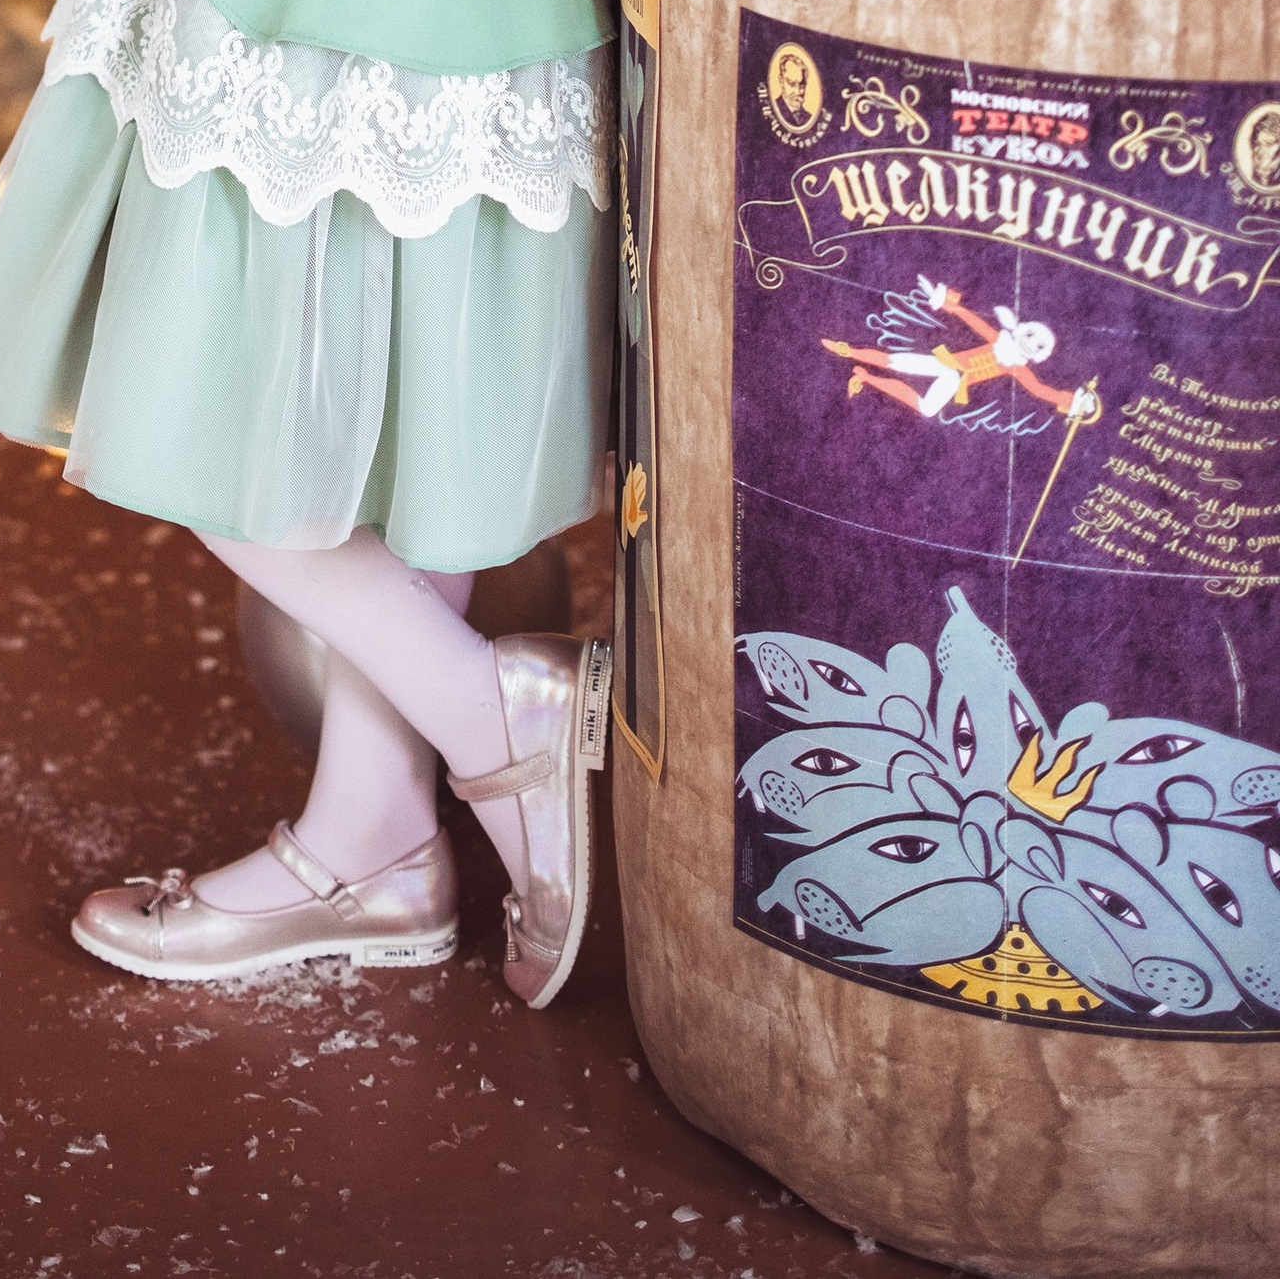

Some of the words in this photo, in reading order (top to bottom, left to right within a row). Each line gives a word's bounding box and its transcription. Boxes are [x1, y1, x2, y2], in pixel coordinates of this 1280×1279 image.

[950, 88, 1090, 121] МОСКОВСКИЙ
[952, 109, 1089, 145] ТЕАТР
[951, 133, 1090, 170] КУКОЛ
[587, 709, 596, 742] miki
[592, 659, 602, 692] miki
[384, 949, 416, 957] miki
